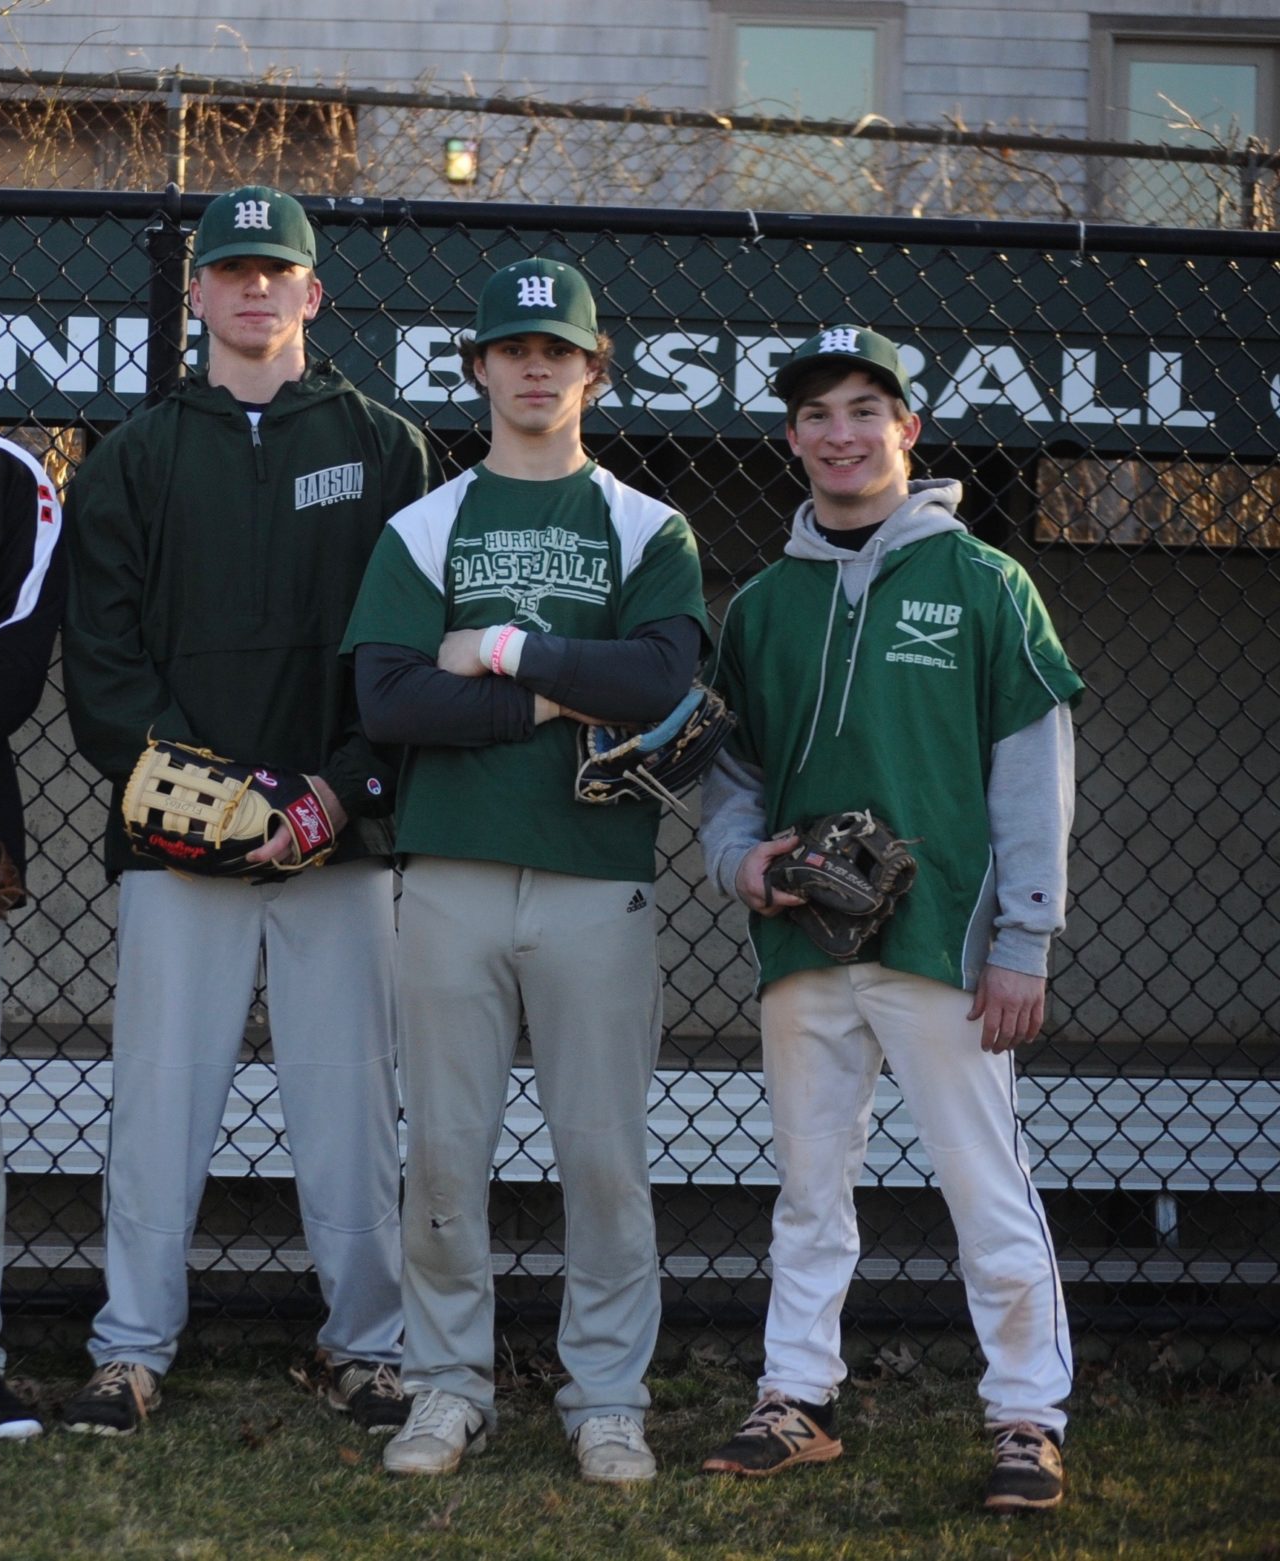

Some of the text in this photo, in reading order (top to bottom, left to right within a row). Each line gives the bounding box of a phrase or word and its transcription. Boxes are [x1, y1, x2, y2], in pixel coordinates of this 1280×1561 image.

[394, 325, 1216, 428] BSEALL
[295, 463, 363, 509] BABSON
[485, 526, 579, 552] HURRICANE
[451, 549, 611, 594] BASEBALL
[902, 599, 963, 626] WHB
[885, 651, 959, 670] BASEBALL
